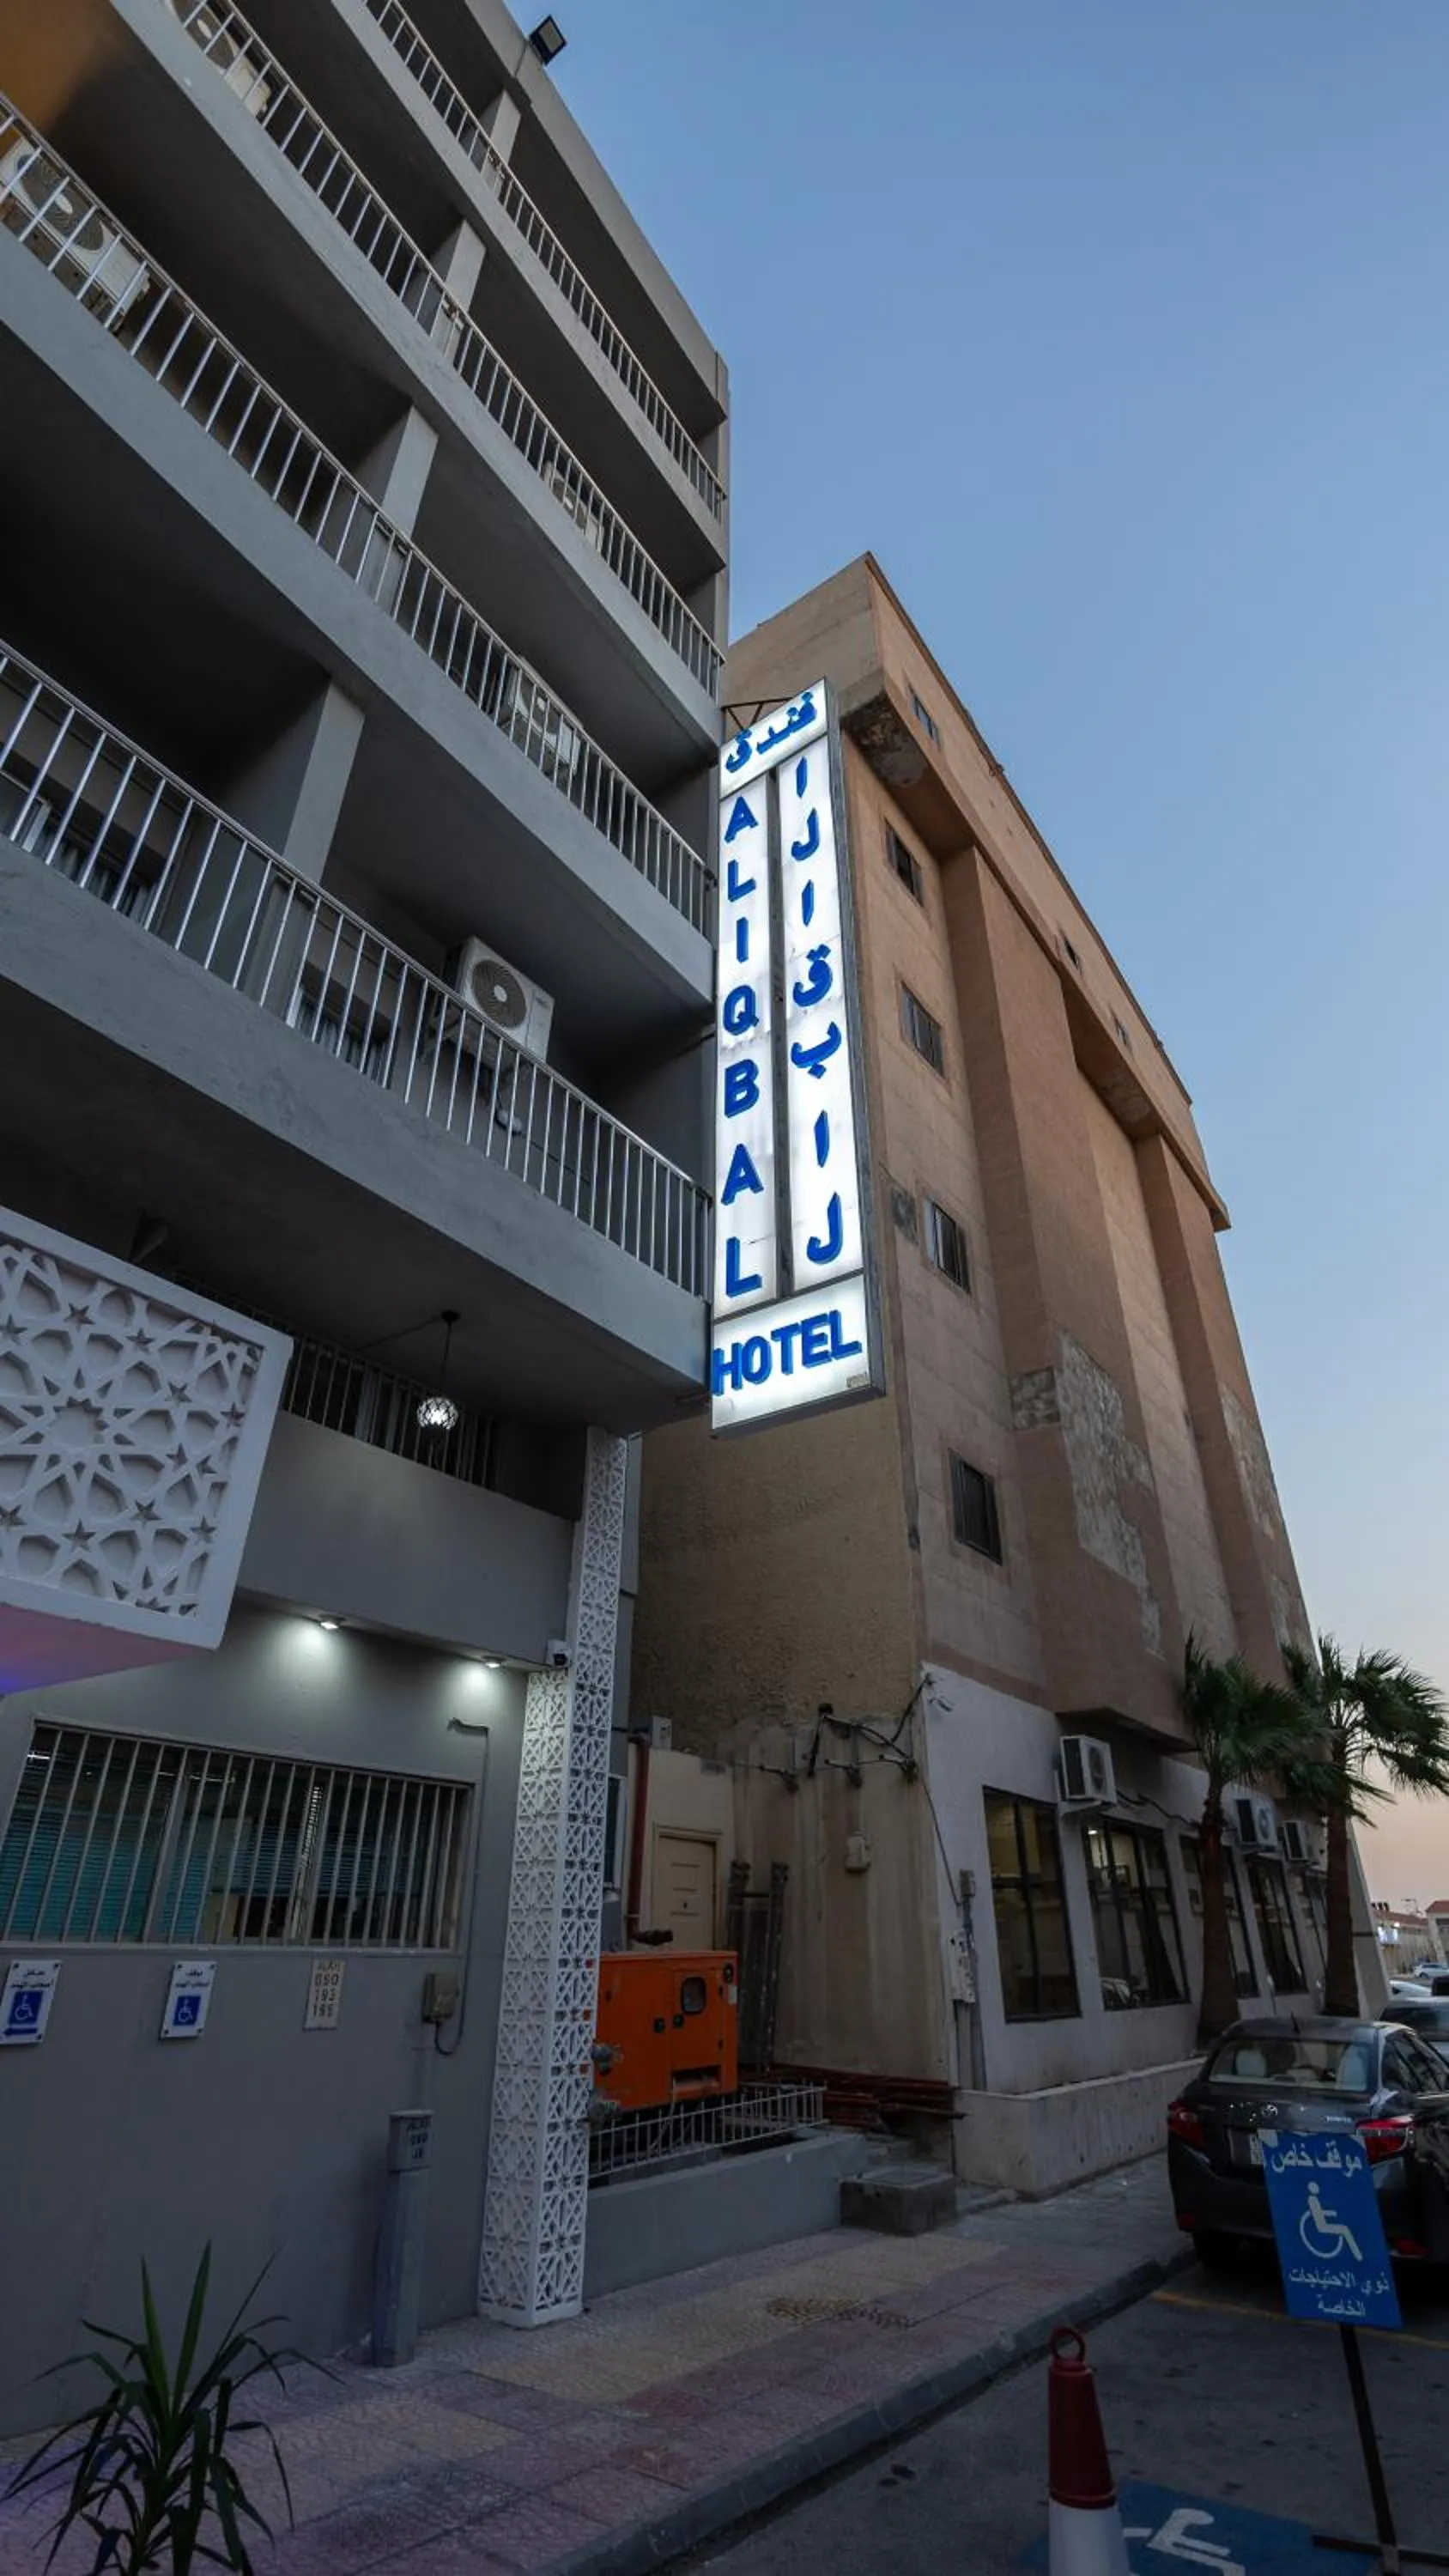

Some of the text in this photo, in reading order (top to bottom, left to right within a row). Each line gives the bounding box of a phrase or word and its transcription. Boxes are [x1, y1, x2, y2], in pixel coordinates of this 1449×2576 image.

[724, 691, 818, 774] فندق
[712, 1309, 863, 1397] HOTEL
[1316, 2141, 1362, 2178] موقف
[1318, 2293, 1366, 2318] الخاصة
